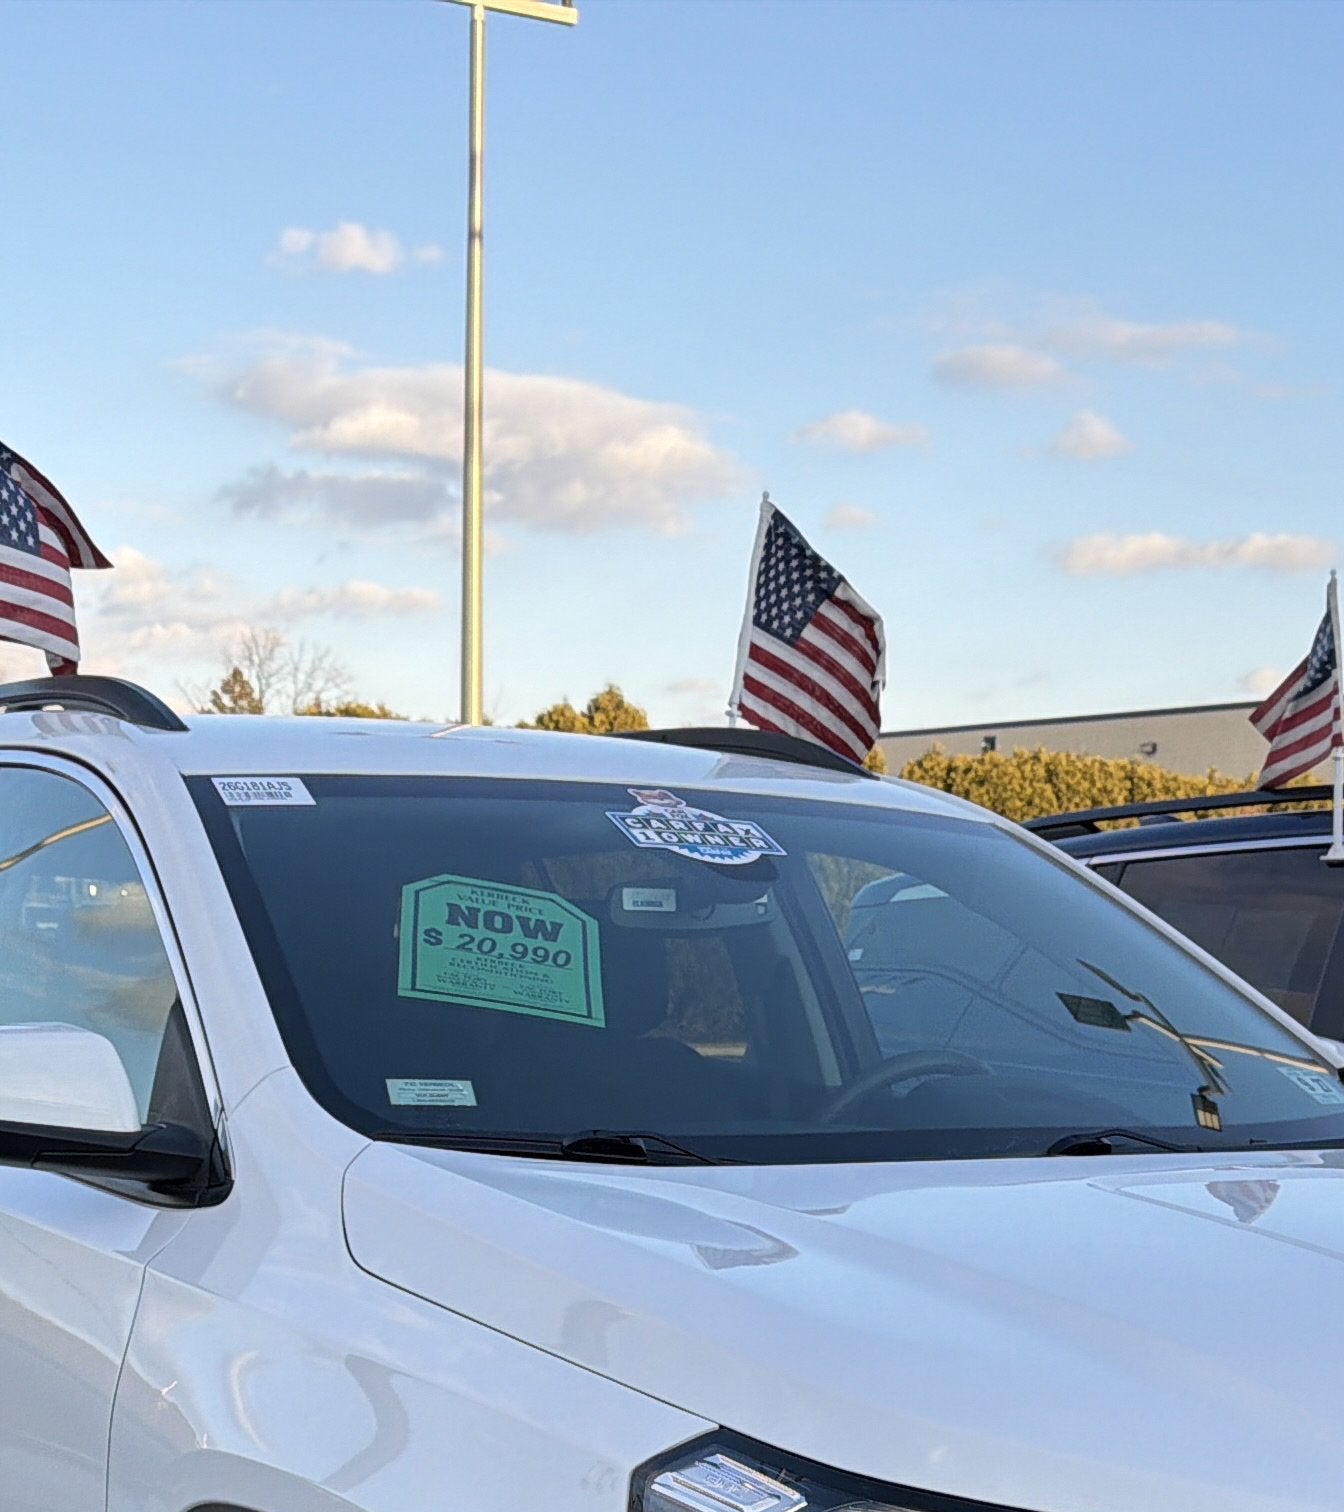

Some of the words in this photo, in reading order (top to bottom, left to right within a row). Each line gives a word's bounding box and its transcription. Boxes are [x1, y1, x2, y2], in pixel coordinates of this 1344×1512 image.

[624, 817, 764, 838] CARFAX
[662, 832, 770, 849] OWNER
[457, 894, 498, 908] VALUE
[507, 903, 545, 916] PRICE
[445, 902, 564, 943] NOW
[423, 927, 443, 946] $
[455, 933, 573, 968] 20,990
